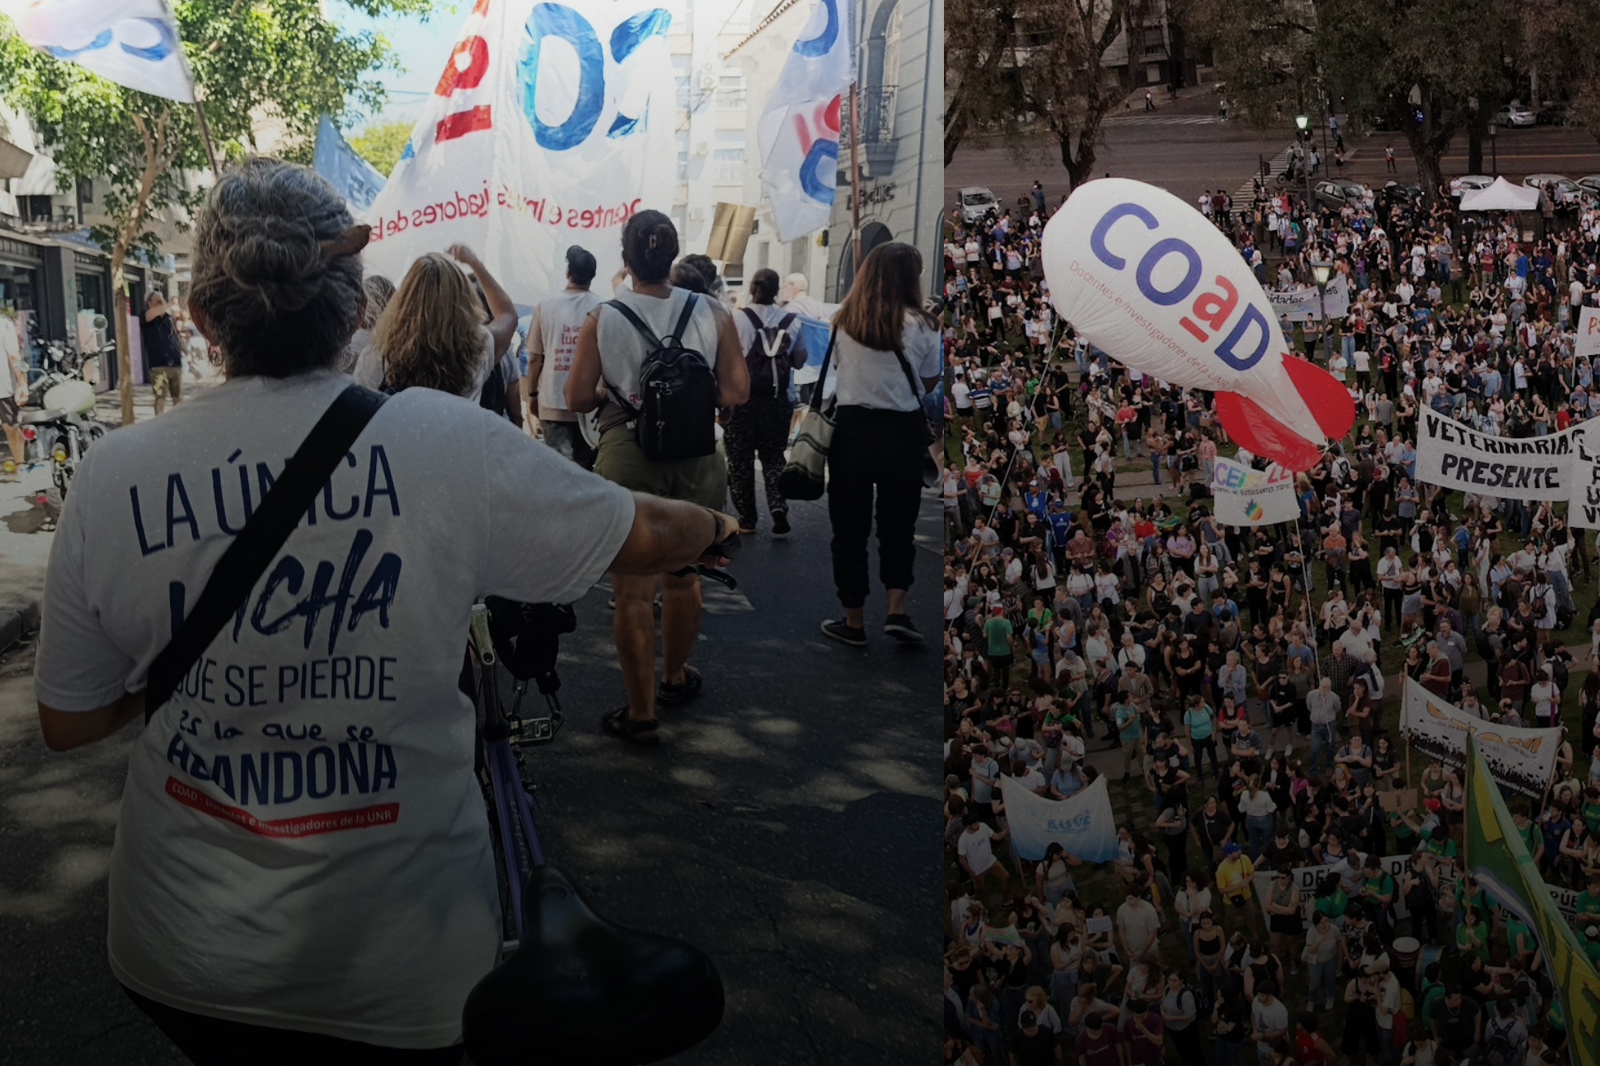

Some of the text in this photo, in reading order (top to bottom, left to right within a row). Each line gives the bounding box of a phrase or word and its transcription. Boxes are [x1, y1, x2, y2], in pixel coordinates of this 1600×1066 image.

[1070, 260, 1114, 299] Docentes
[1122, 301, 1188, 358] Investigadores
[1207, 371, 1229, 387] UNR
[1441, 453, 1560, 489] PRESENTE
[130, 472, 201, 556] LA
[224, 665, 267, 706] SE
[279, 656, 397, 702] PIERDE
[171, 782, 198, 802] COAD
[340, 814, 354, 827] de
[355, 813, 365, 825] la
[367, 809, 392, 823] UNR
